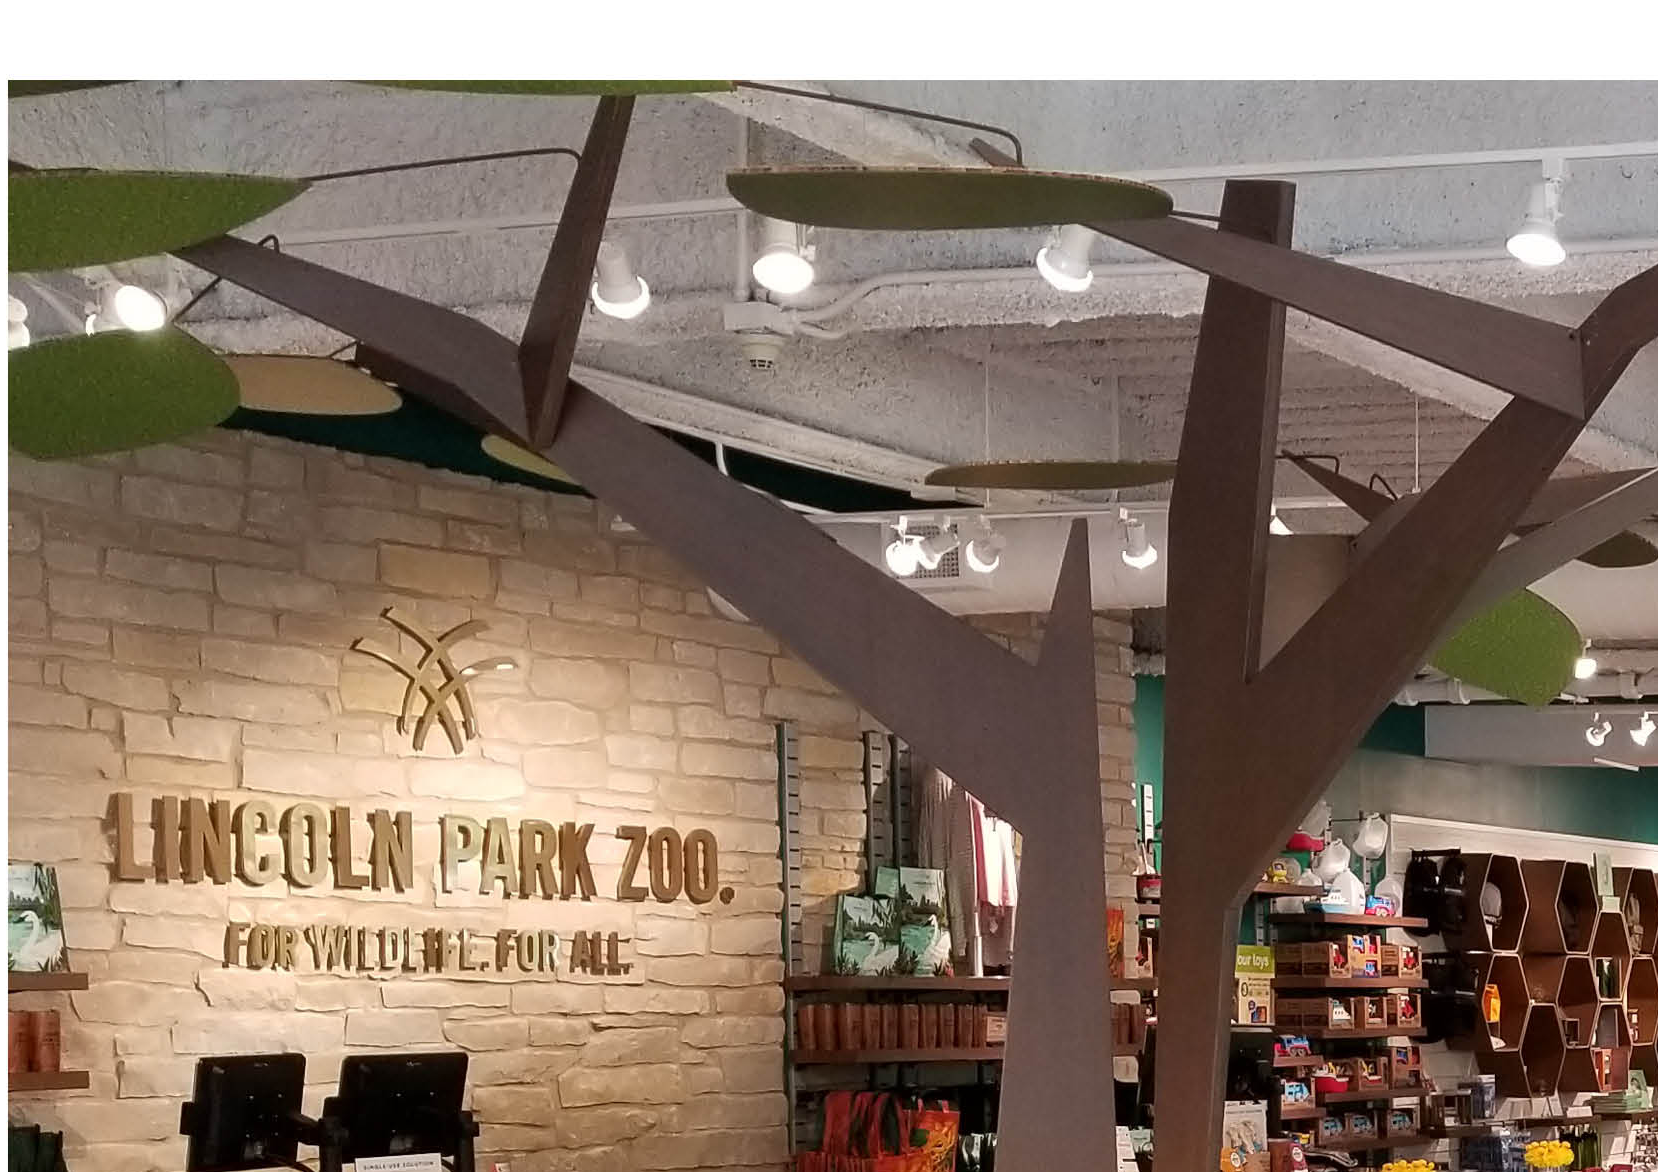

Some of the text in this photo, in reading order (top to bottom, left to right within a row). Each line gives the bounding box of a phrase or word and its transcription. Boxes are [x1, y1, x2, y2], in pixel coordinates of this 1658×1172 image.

[106, 793, 735, 904] LINCOLN PARK ZOO.
[223, 921, 634, 975] FOR WILDLIFE. FOR ALL.
[1237, 953, 1269, 970] our toys
